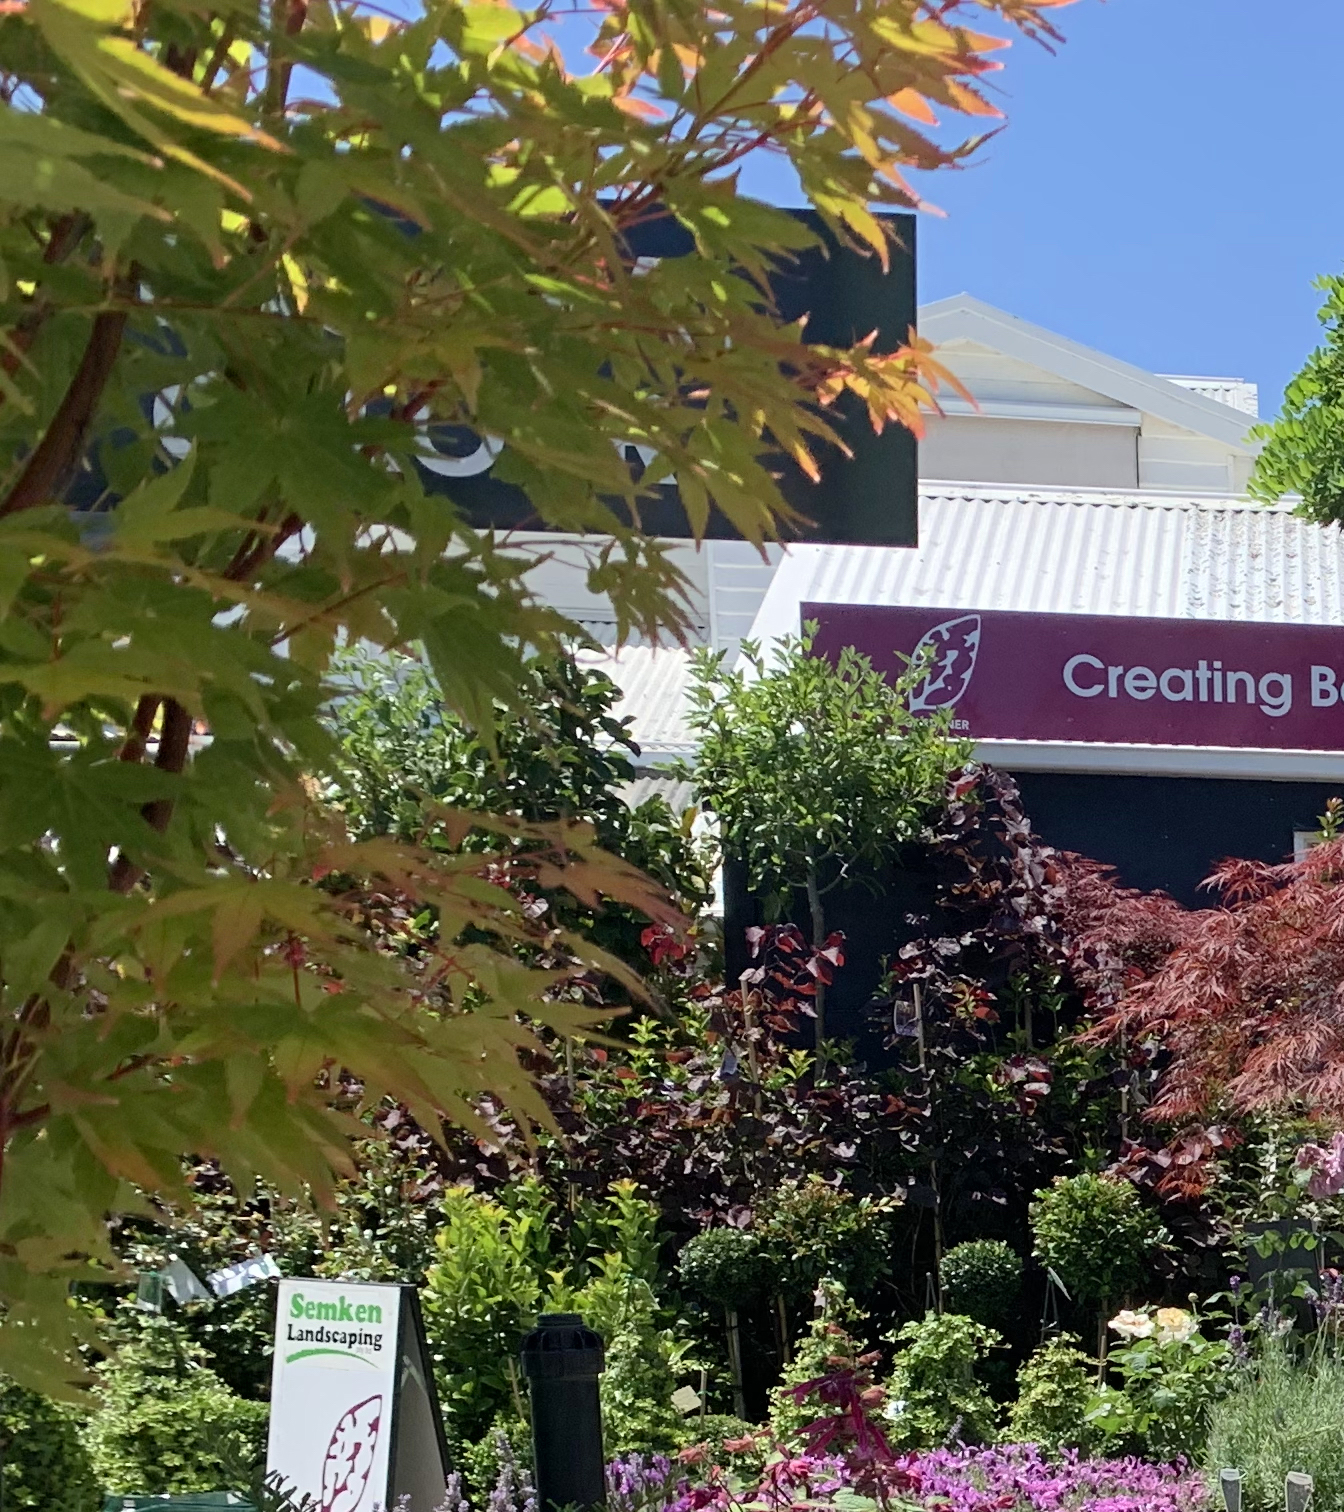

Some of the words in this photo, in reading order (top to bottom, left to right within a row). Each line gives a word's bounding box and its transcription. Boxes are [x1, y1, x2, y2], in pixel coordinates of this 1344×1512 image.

[1062, 653, 1293, 718] Creating
[290, 1292, 383, 1324] Semken
[287, 1323, 383, 1352] Landscaping
